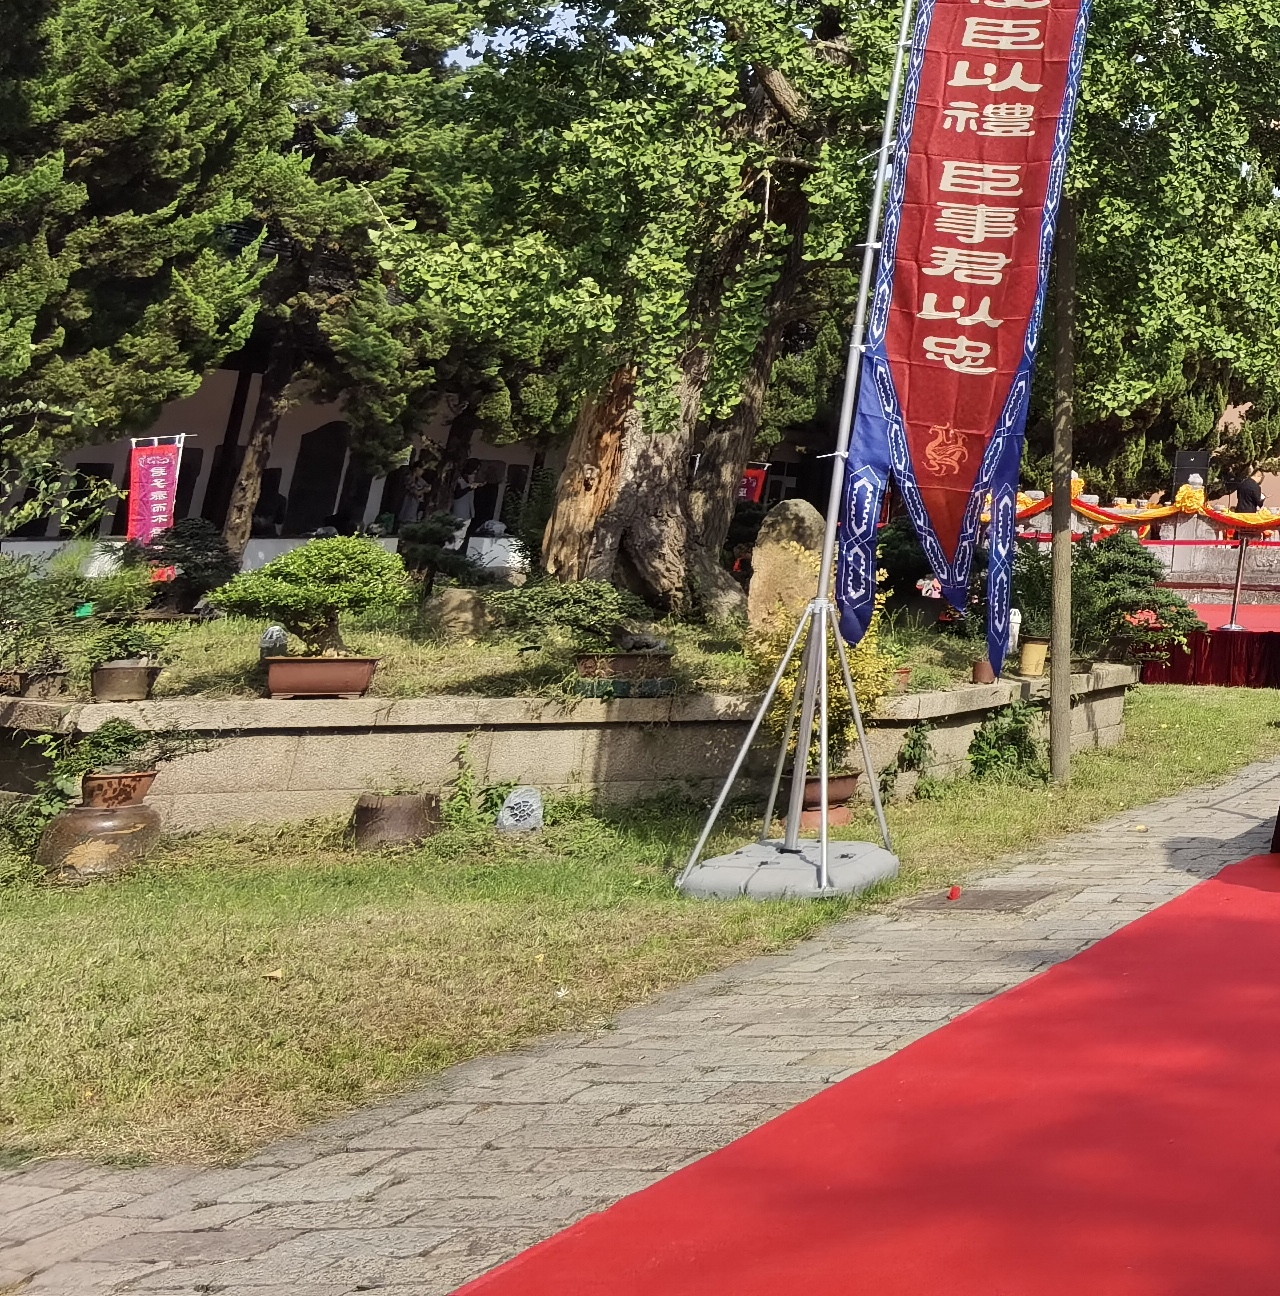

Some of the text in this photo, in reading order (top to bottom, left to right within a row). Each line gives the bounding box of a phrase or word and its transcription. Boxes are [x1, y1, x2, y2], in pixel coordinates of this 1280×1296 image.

[917, 160, 1024, 376] 臣事君以忠
